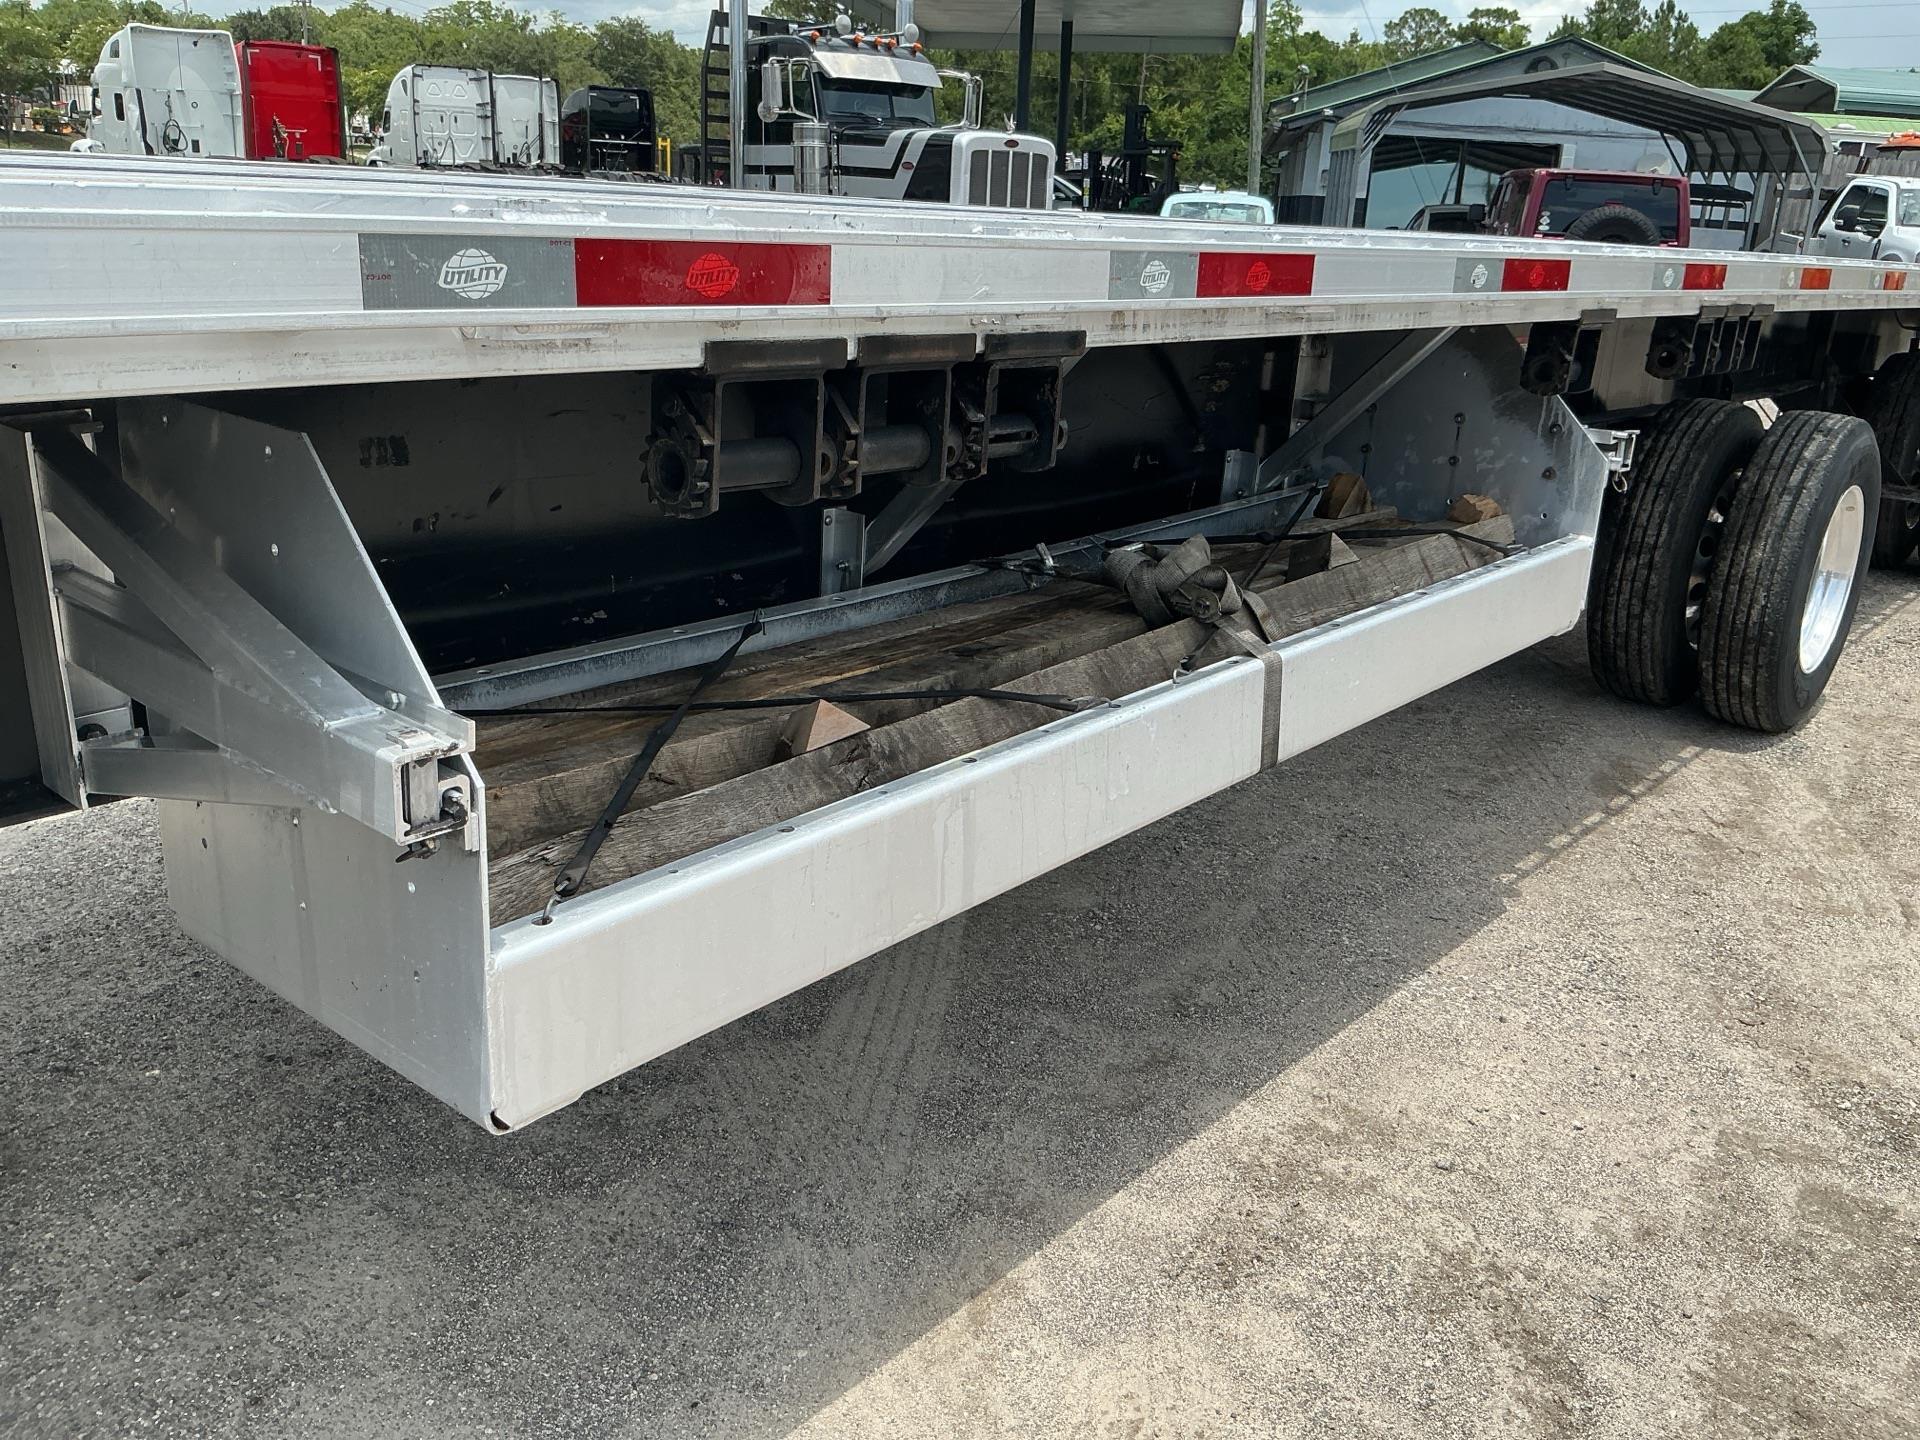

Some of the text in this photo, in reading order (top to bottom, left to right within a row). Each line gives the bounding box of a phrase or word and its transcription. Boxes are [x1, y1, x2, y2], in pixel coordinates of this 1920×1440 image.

[444, 267, 504, 285] UTILITY
[689, 269, 735, 286] UTILITY
[1143, 271, 1168, 284] UTILITY
